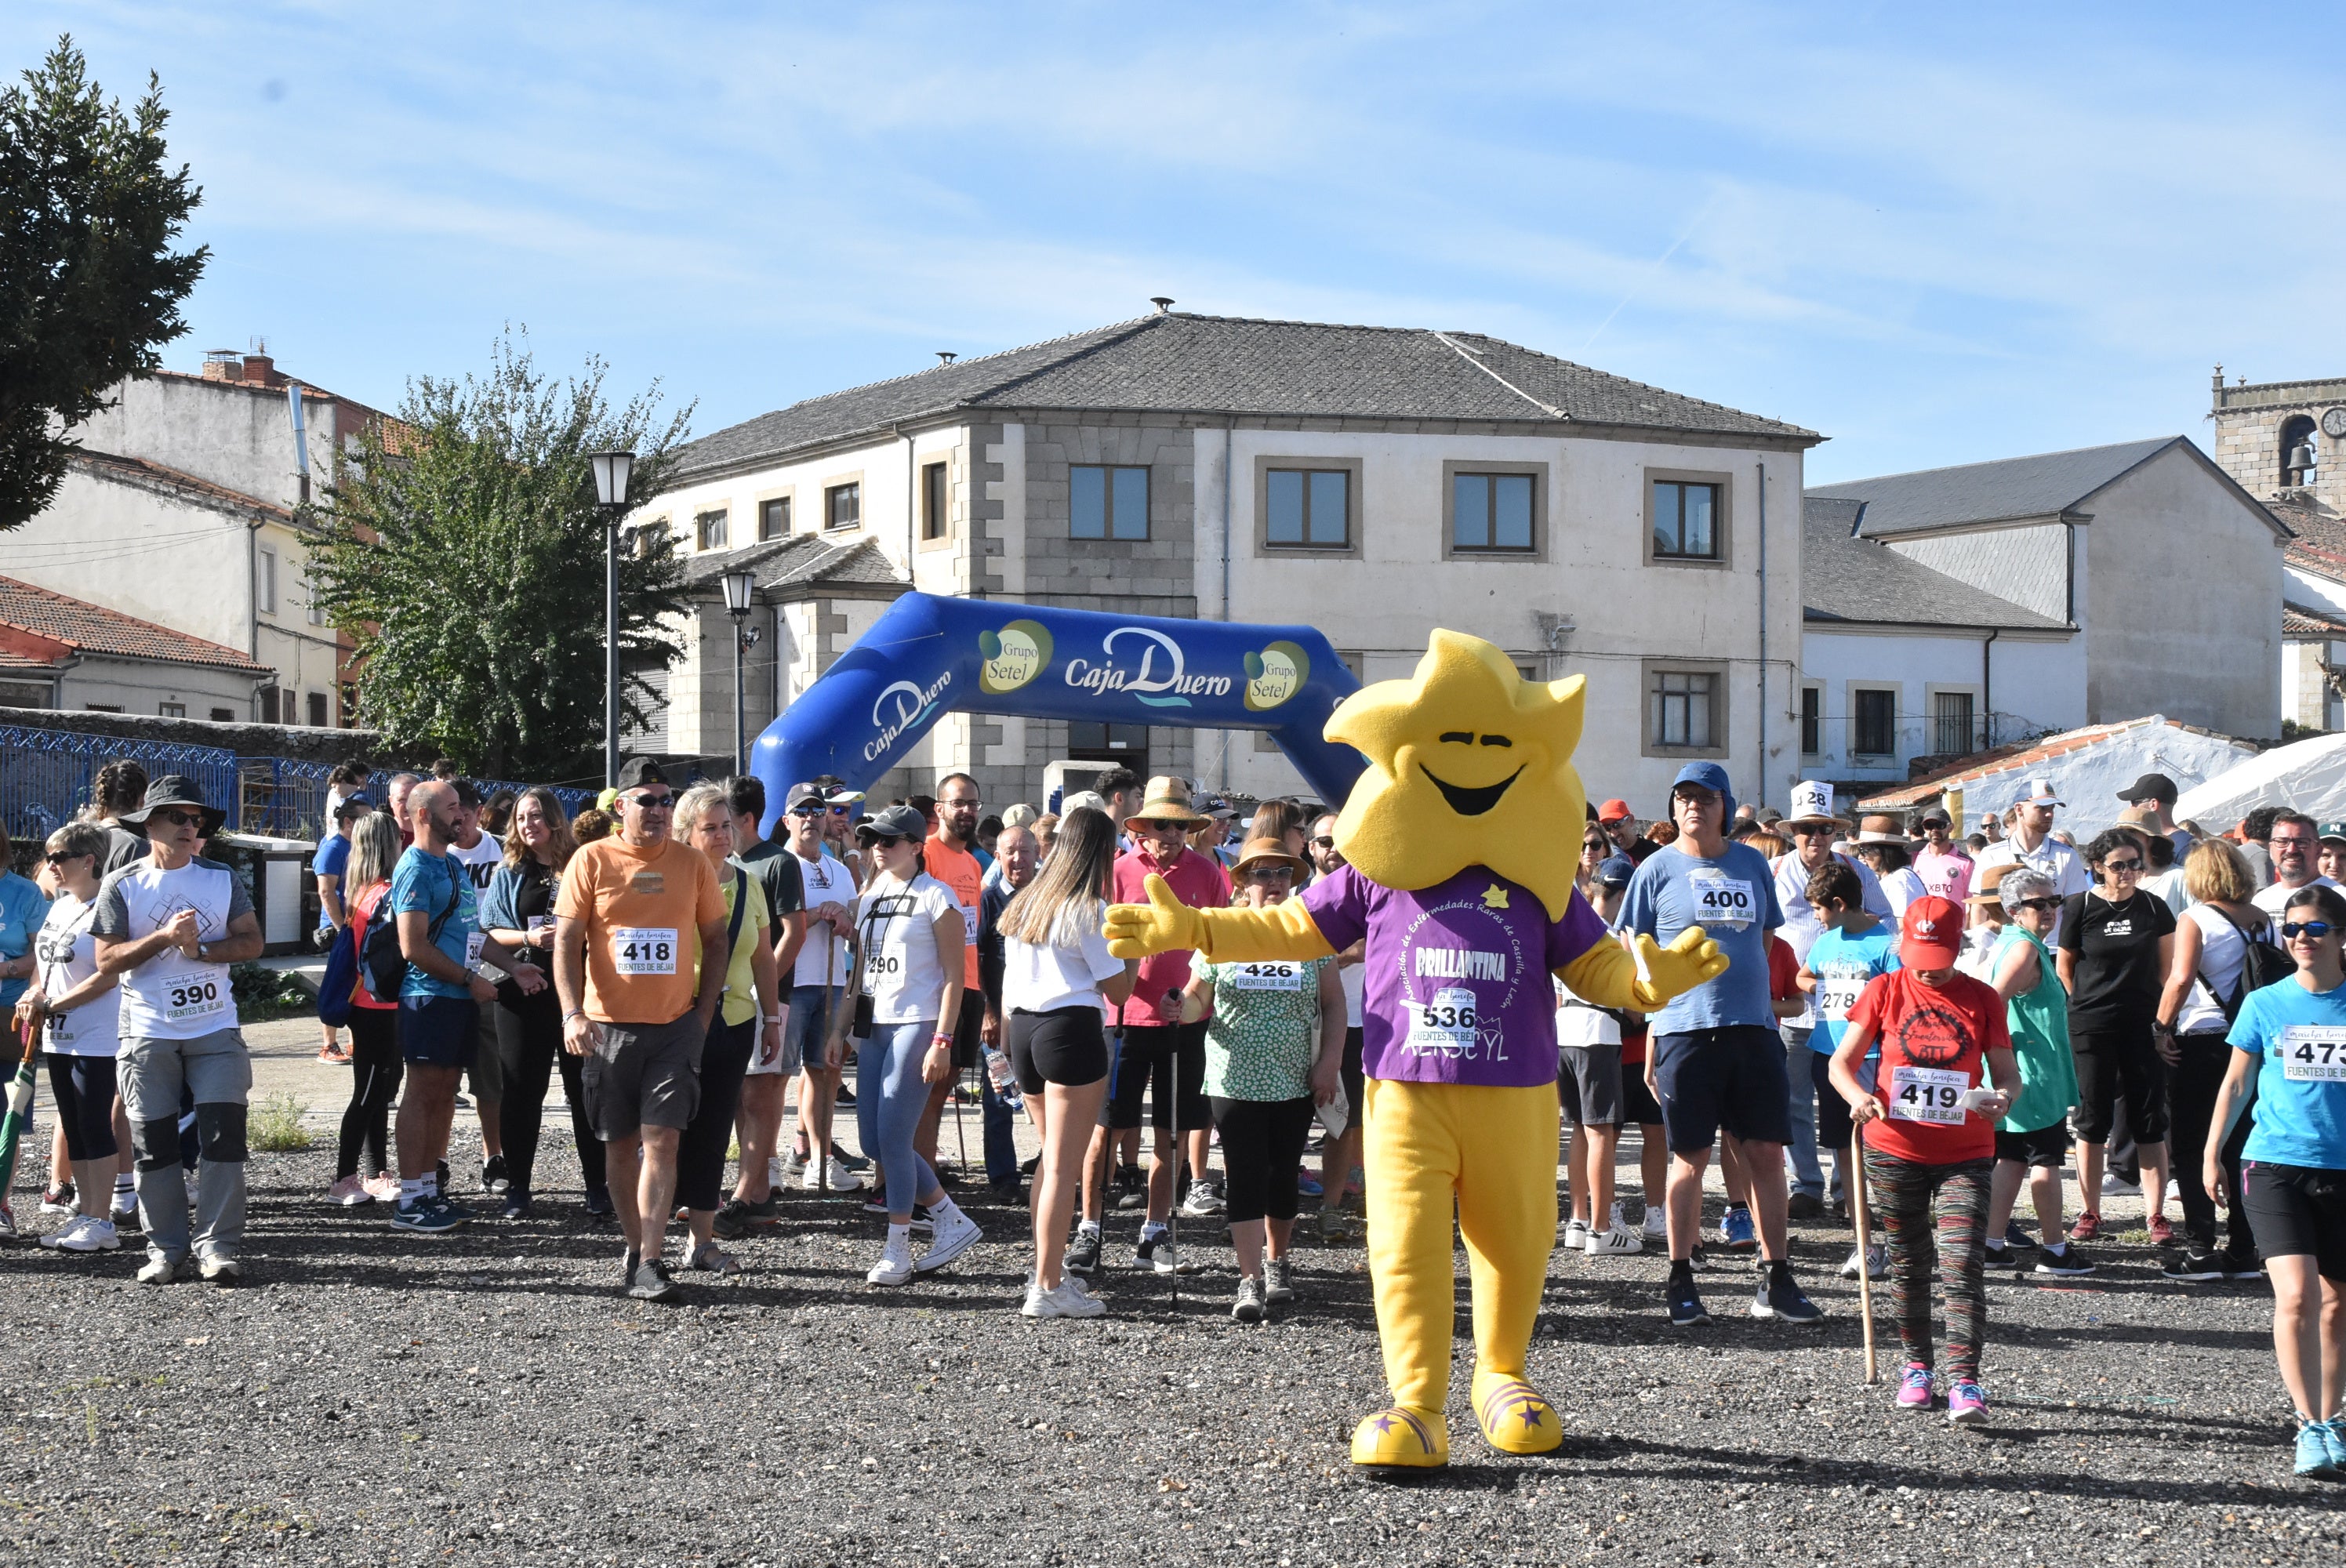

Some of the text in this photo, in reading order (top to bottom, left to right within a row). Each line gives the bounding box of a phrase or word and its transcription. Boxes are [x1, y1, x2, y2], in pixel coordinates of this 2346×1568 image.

[1004, 643, 1037, 660] Grupo
[1065, 627, 1231, 695] Caja Duero
[989, 661, 1027, 680] Setel
[1266, 662, 1296, 679] Grupo
[1251, 680, 1287, 698] Setel
[864, 671, 951, 761] Caja Duero
[1929, 884, 1952, 893] XBTO
[1703, 891, 1748, 908] 400
[1408, 899, 1474, 933] Enfermedades
[1477, 904, 1504, 924] Raras
[1736, 909, 1754, 918] BÉJAR
[620, 931, 644, 939] marcha
[1504, 925, 1513, 936] de
[1401, 935, 1411, 947] de
[623, 942, 670, 961] 418
[1512, 939, 1524, 974] Castilla
[657, 962, 674, 971] BÉJAR
[1245, 964, 1293, 978] 426
[1415, 946, 1505, 982] BRILLANTINA
[165, 977, 191, 986] marcha
[1279, 978, 1298, 987] BÉJAR
[1398, 951, 1416, 1000] Asociación
[171, 982, 216, 1007] 390
[1501, 987, 1517, 1009] León
[1821, 993, 1855, 1008] 278
[167, 1001, 224, 1018] FUENTES DE BÉJAR
[1423, 1007, 1475, 1028] 536
[1414, 1030, 1475, 1041] FUENTES DE BÉJ
[2290, 1030, 2322, 1039] marcha
[1898, 1071, 1927, 1080] marcha
[2288, 1067, 2325, 1076] FUENTES
[2328, 1068, 2338, 1077] DE
[1901, 1083, 1958, 1109] 419
[1892, 1106, 1963, 1121] FUENTES DE BÉJAR
